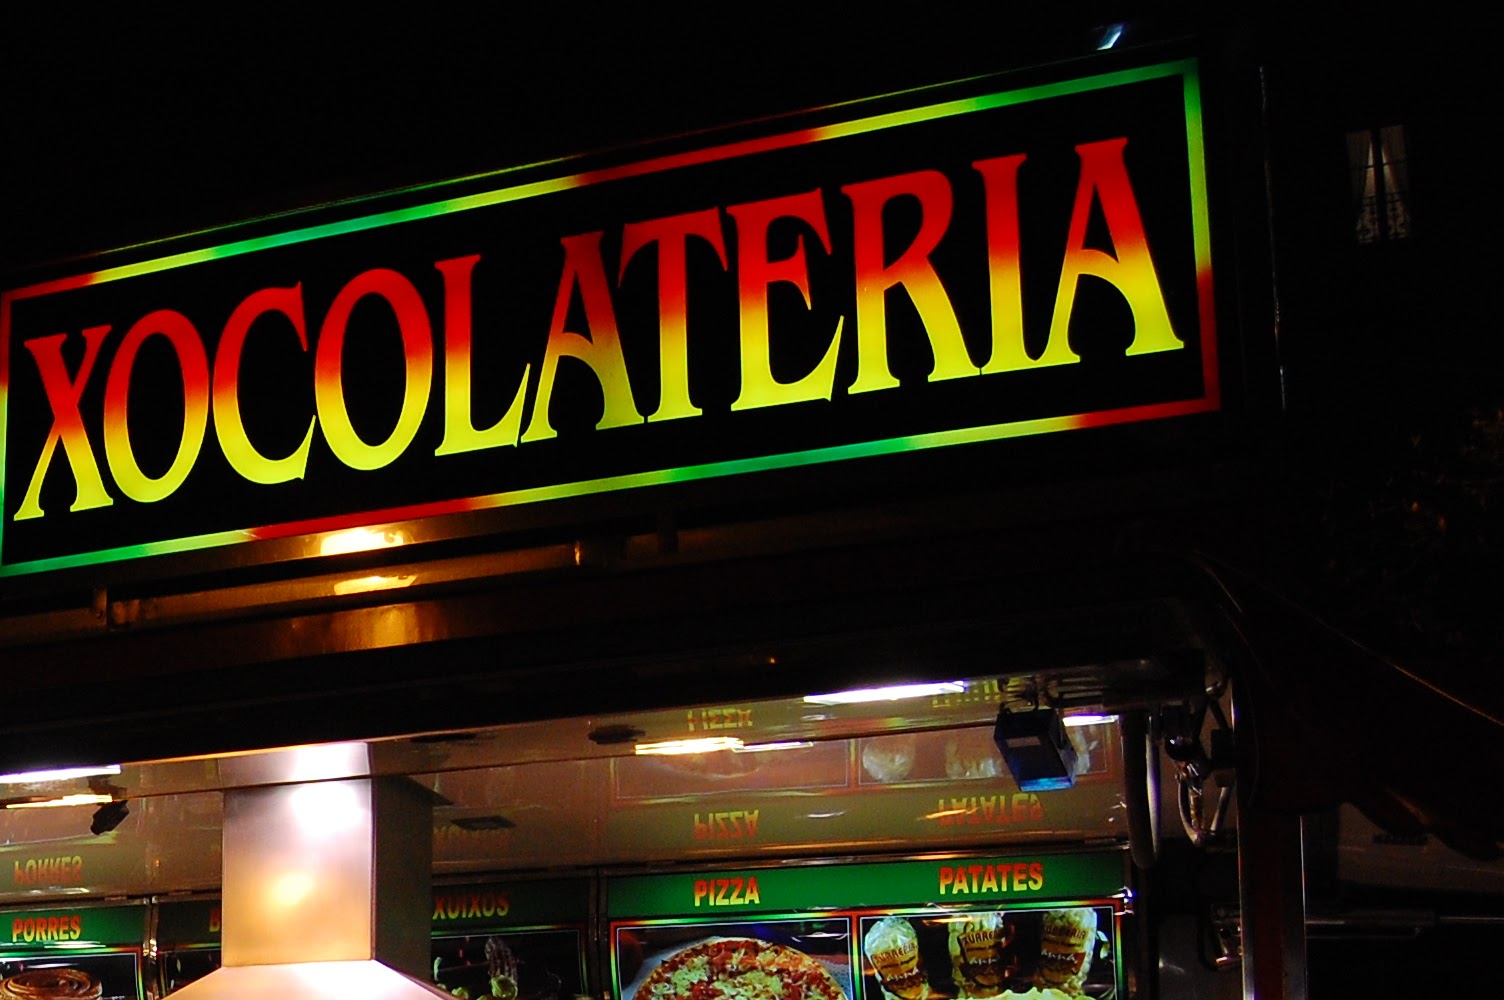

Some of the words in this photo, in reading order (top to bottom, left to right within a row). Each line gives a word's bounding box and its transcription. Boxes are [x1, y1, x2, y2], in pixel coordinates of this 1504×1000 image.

[12, 137, 1184, 522] XOCOLATERIA
[694, 877, 761, 907] PIZZA
[938, 862, 1045, 896] PATATES
[12, 915, 81, 942] PORRES
